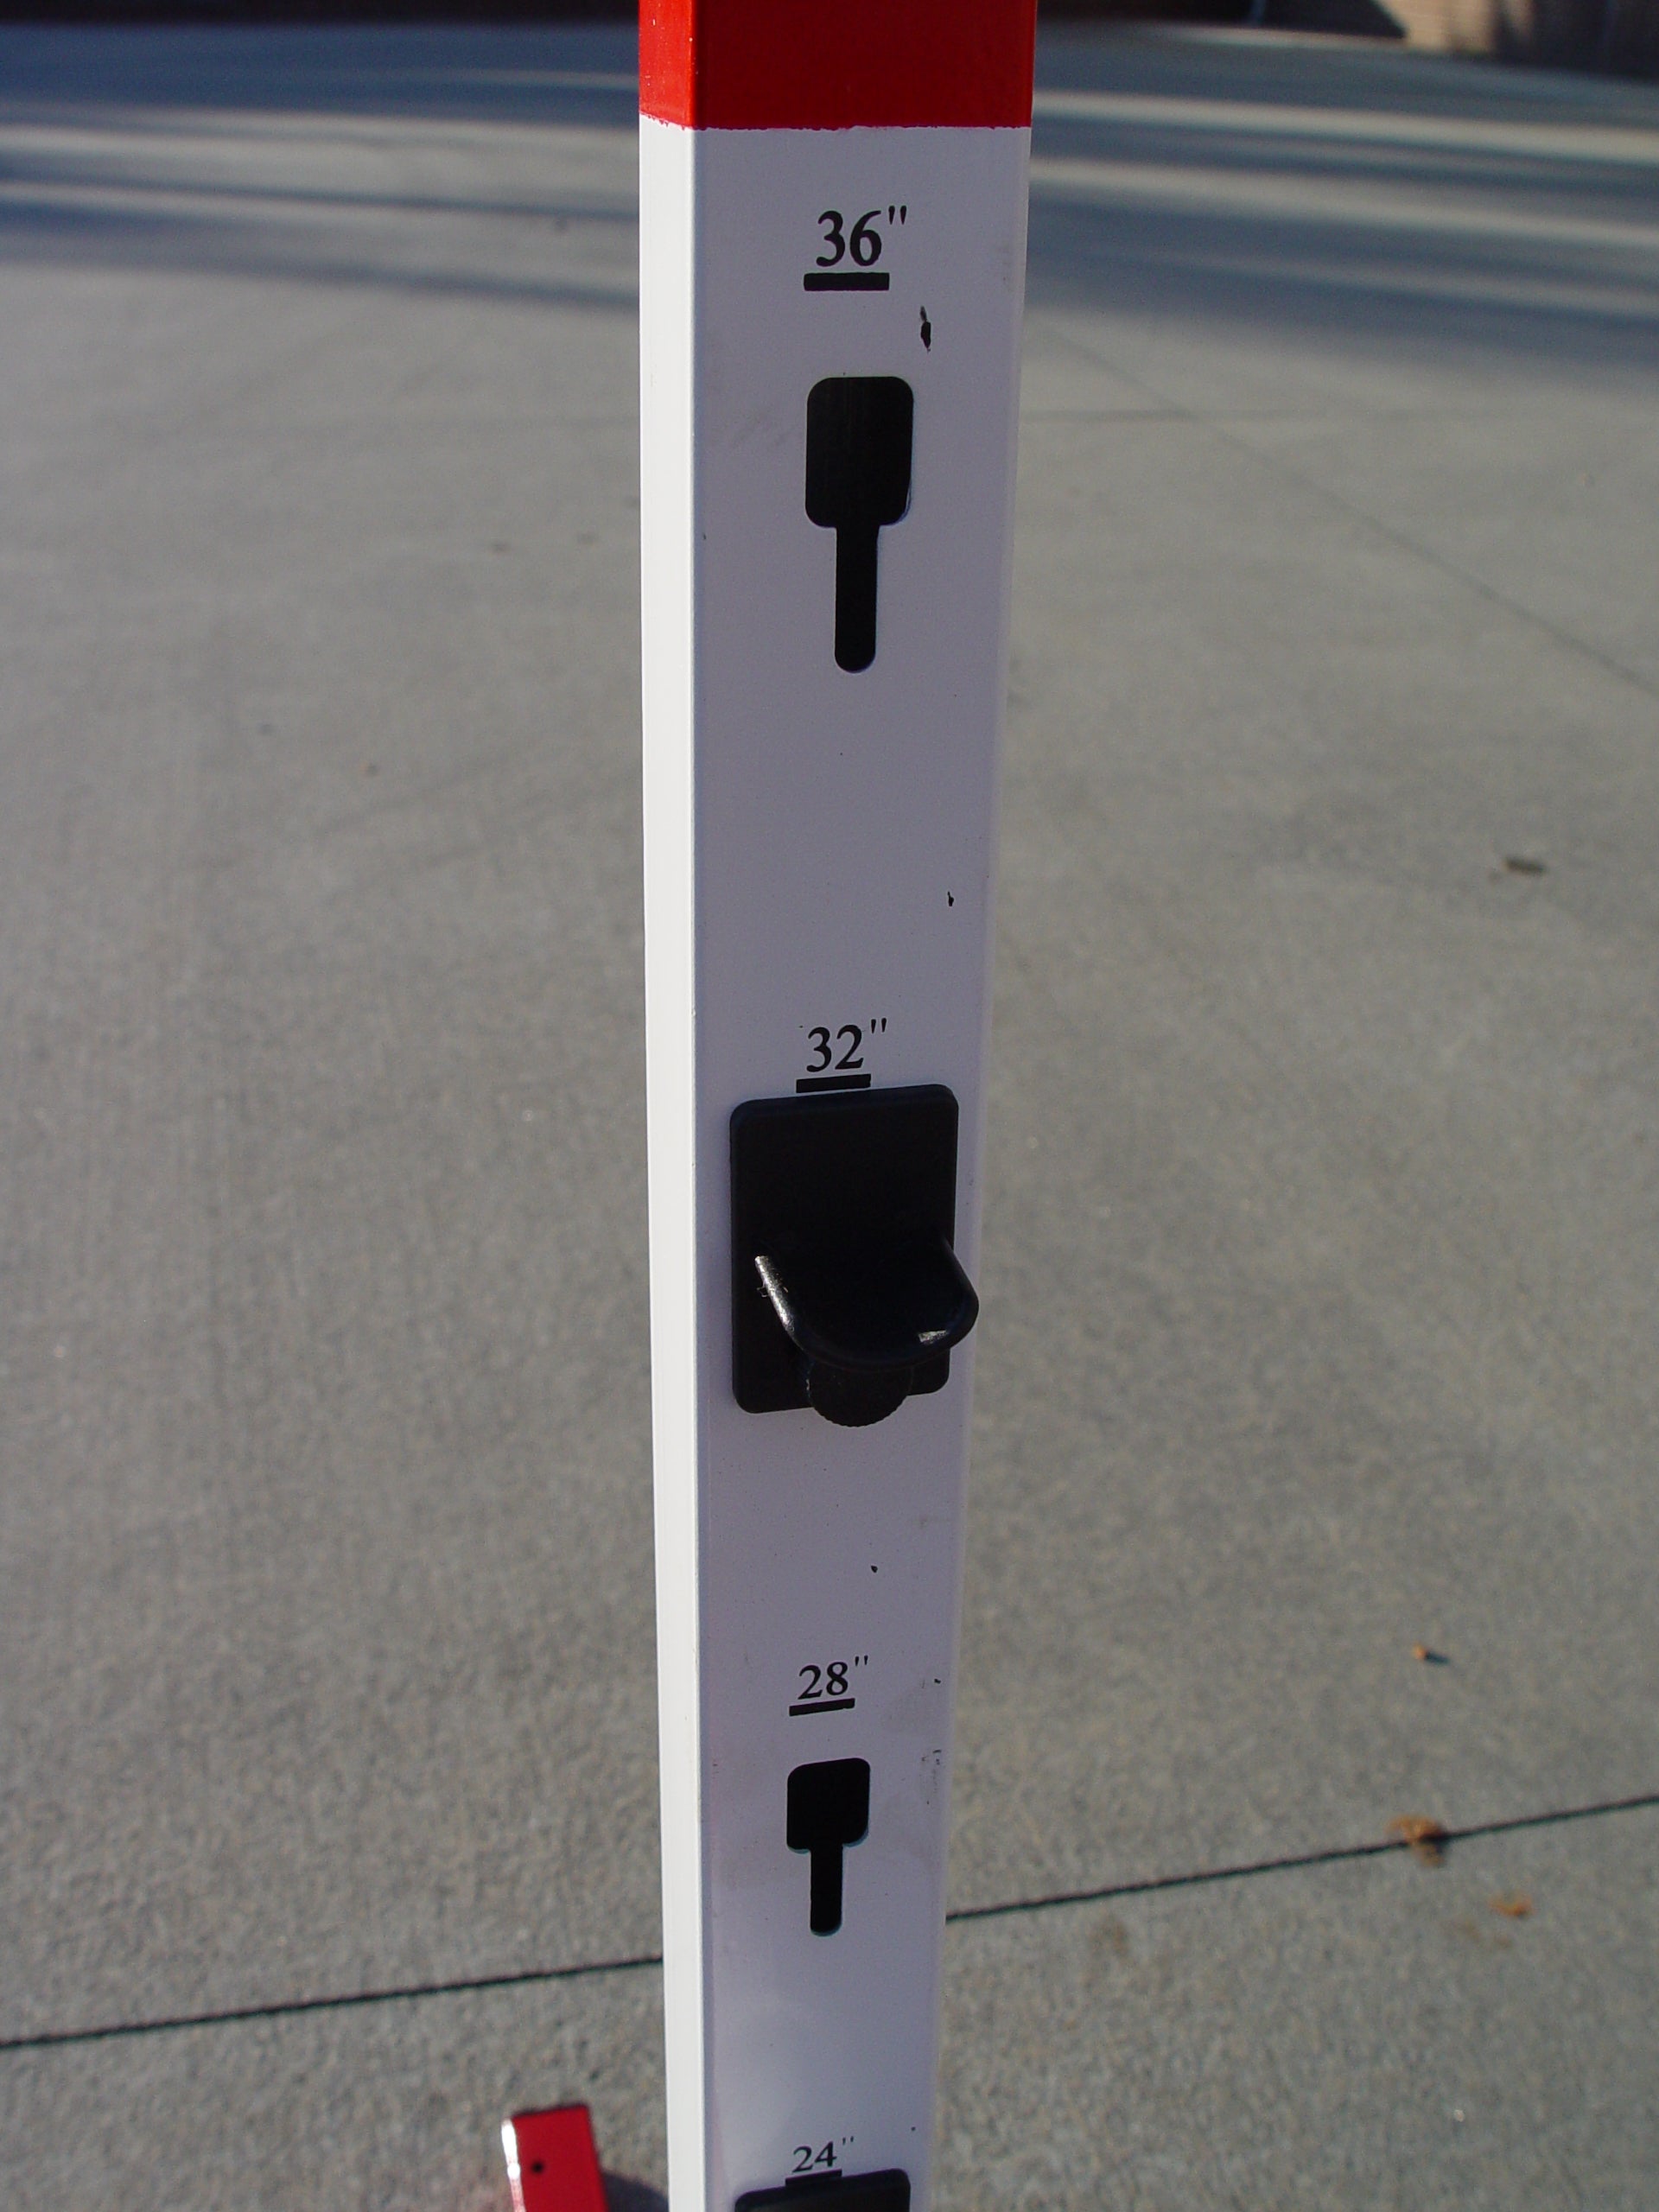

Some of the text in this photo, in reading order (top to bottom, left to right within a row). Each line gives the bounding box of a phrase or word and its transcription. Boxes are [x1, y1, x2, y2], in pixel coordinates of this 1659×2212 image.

[815, 204, 908, 268] 36"
[805, 1017, 887, 1073] 32"
[797, 1654, 869, 1700] 28"
[791, 2135, 855, 2173] 24"
